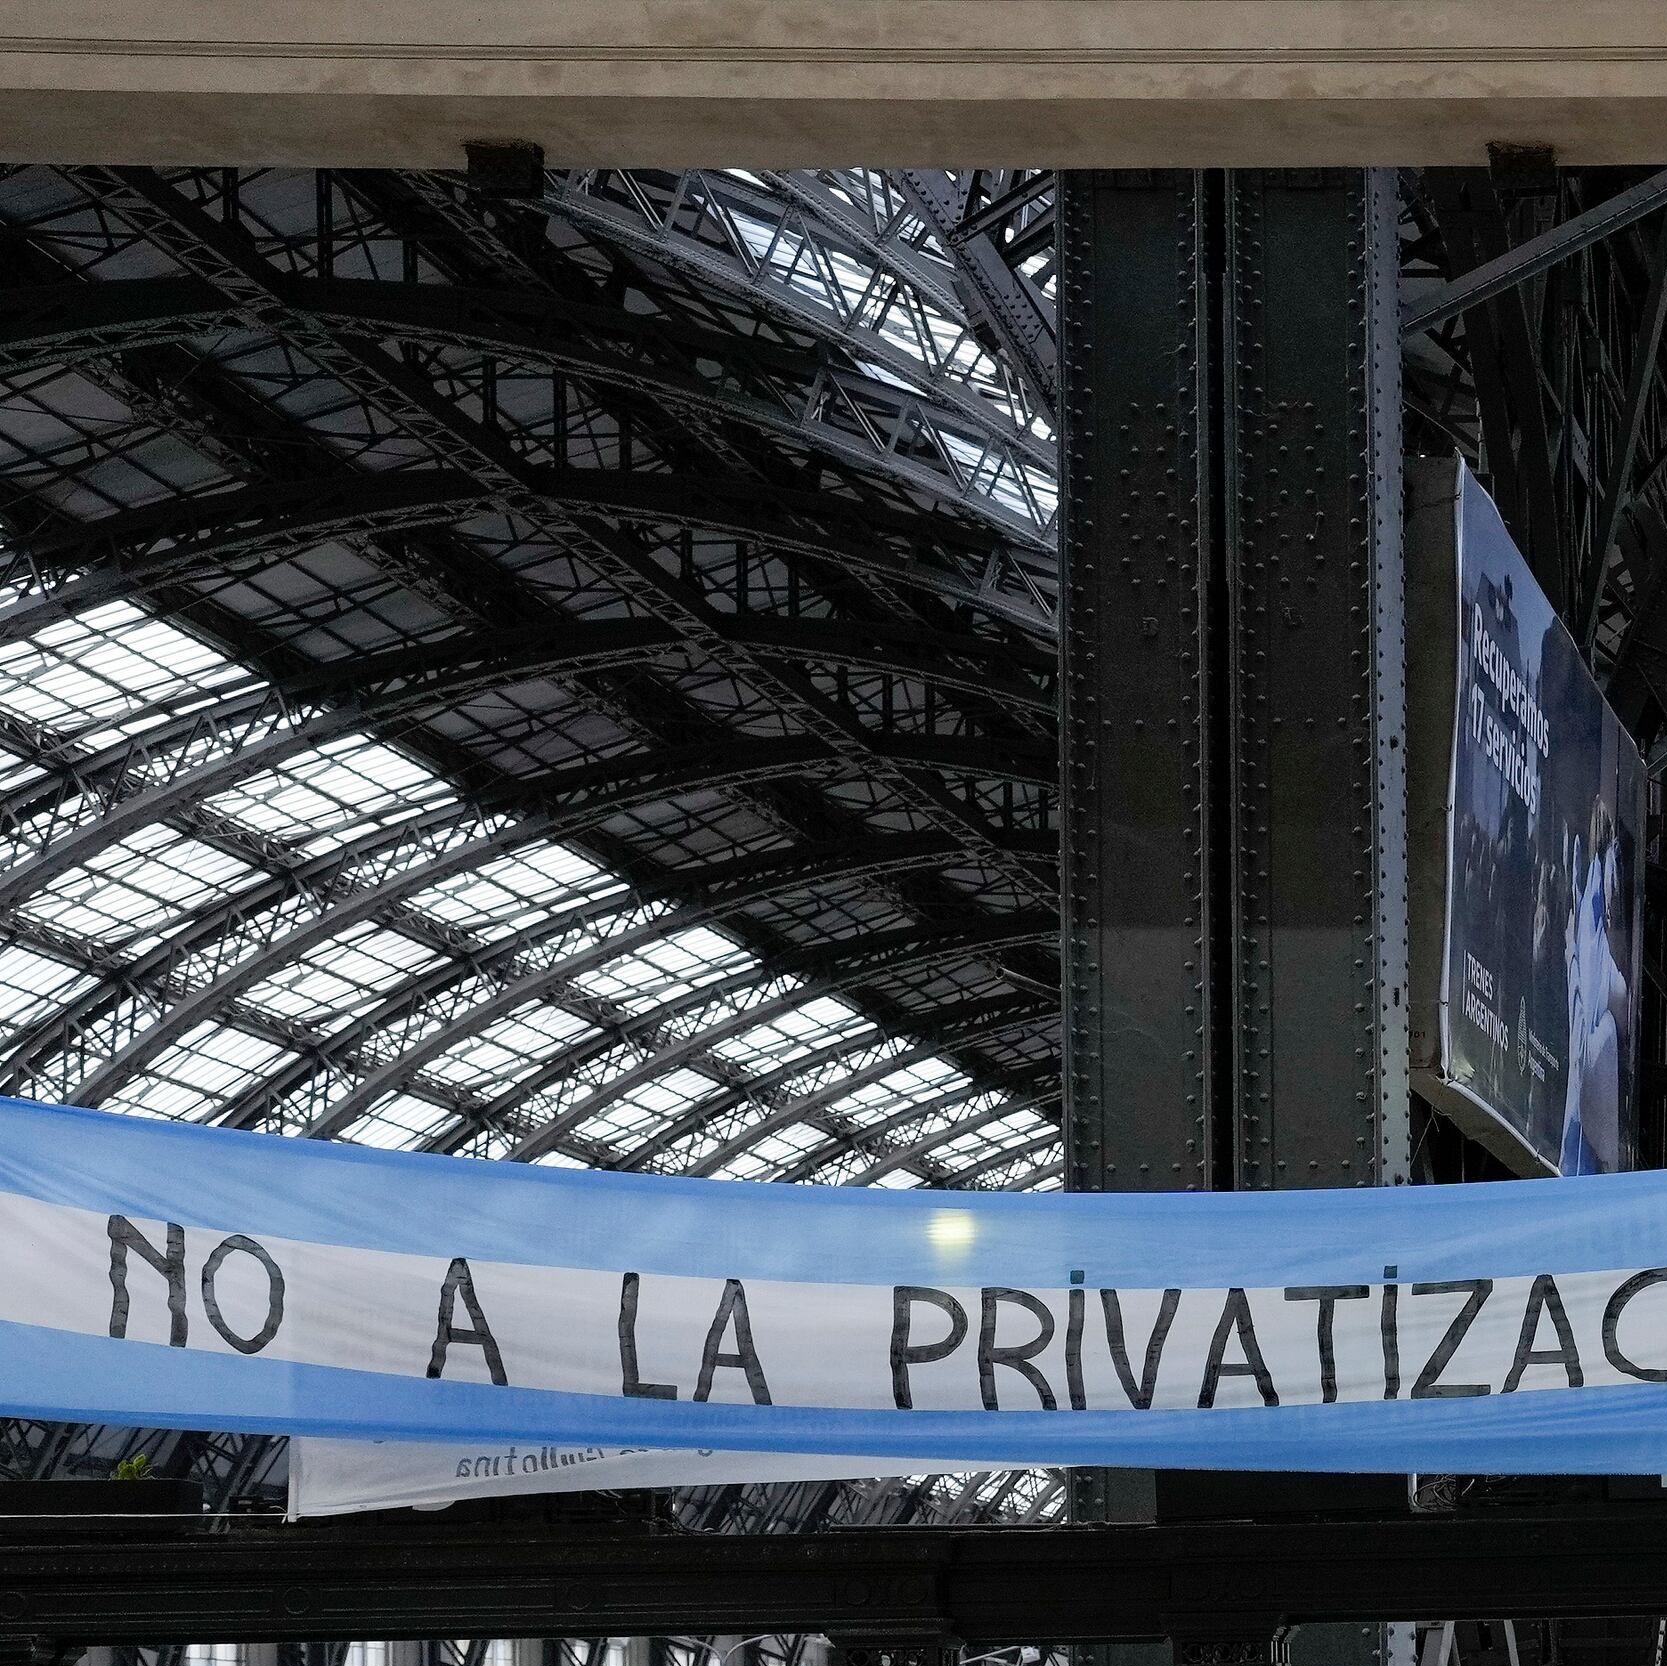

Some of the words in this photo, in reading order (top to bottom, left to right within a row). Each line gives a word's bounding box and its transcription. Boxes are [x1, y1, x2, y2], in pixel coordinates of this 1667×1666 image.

[1474, 602, 1549, 758] Recuperamos
[1472, 683, 1485, 743] 17
[1486, 715, 1537, 814] servicios
[1465, 990, 1508, 1051] ARGENTINOS
[1467, 952, 1493, 1000] TRENES
[108, 1214, 285, 1355] NO
[425, 1258, 508, 1386] A
[621, 1271, 772, 1407] LA
